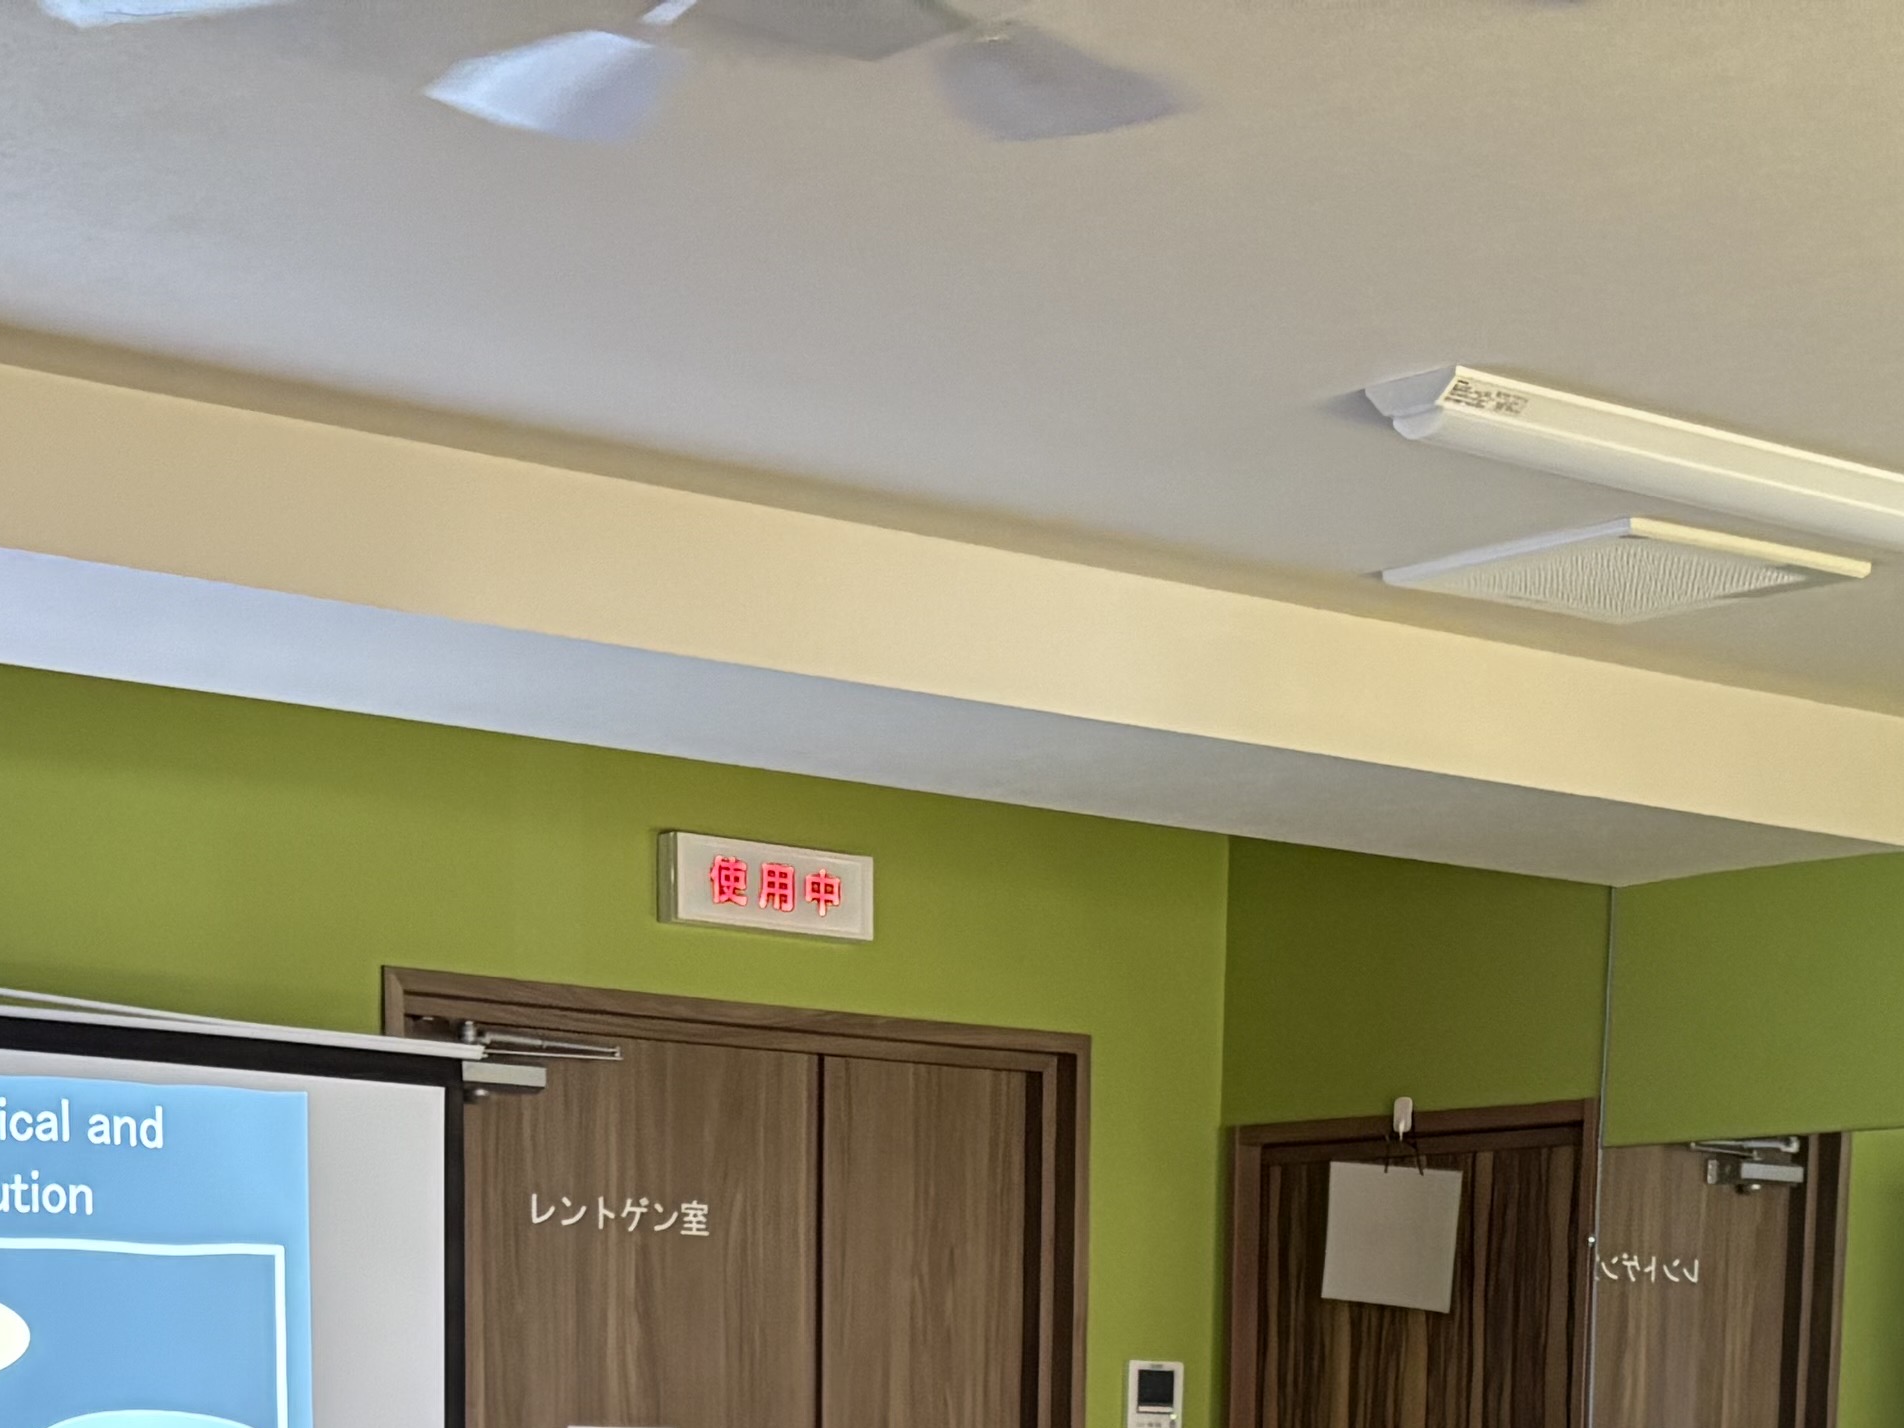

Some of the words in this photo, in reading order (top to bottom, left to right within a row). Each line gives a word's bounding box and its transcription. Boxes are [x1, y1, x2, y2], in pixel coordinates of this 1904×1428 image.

[709, 855, 841, 916] 使用中
[88, 1106, 163, 1148] and
[532, 1194, 709, 1236] レントゲン室
